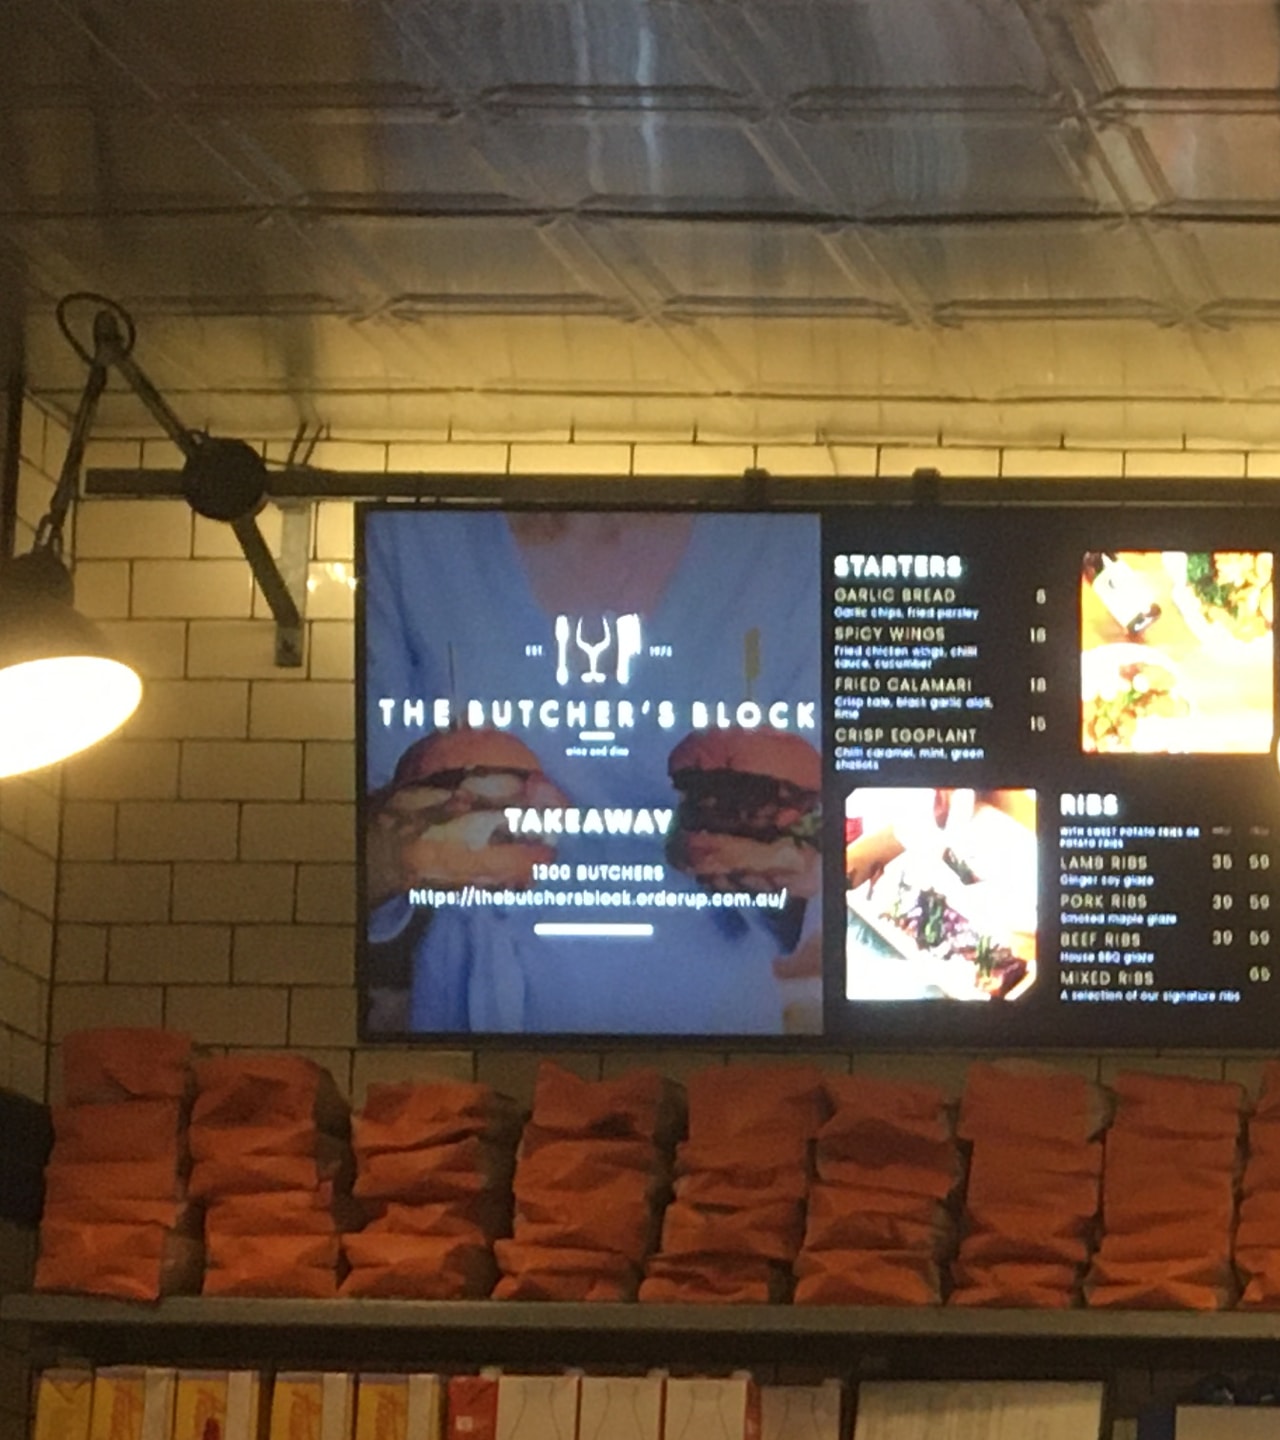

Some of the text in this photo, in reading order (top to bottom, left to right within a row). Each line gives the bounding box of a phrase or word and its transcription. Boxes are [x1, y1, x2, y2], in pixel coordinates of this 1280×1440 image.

[834, 555, 962, 578] STARTERS
[835, 588, 955, 602] GARLIC BREAD
[835, 627, 944, 641] SPICY WINGS
[836, 677, 971, 691] FRIED CALAMARI
[379, 699, 815, 729] THE BUTCHER'S BLOCK
[835, 728, 975, 743] CRISP EGGPLANT
[1061, 794, 1118, 816] RIBS
[504, 808, 672, 835] TAKEAWAY
[1061, 856, 1147, 870] LAMB RIBS
[533, 864, 664, 882] 1300 BUTCHERS
[1061, 894, 1147, 908] PORK RIBS
[1061, 932, 1140, 947] BEEF RIBS
[1061, 971, 1153, 985] MIXED RIBS
